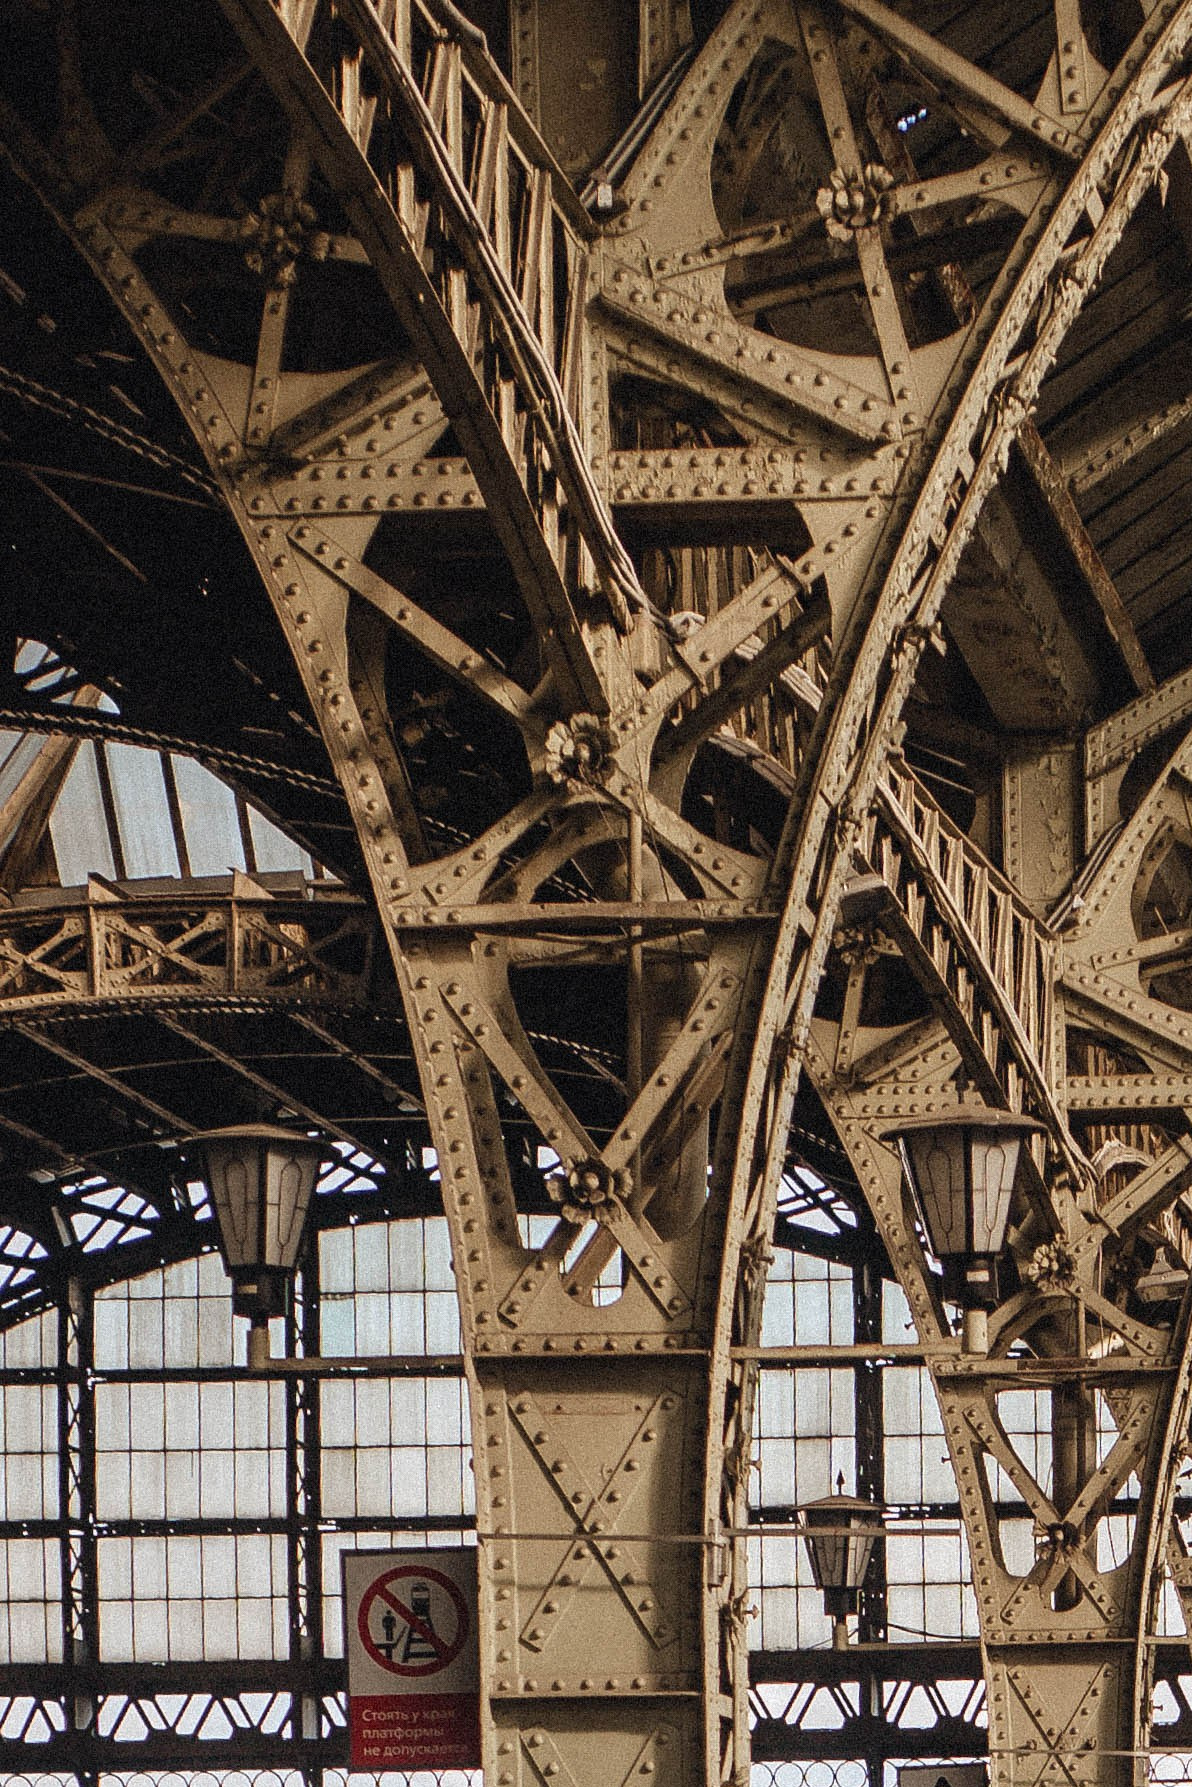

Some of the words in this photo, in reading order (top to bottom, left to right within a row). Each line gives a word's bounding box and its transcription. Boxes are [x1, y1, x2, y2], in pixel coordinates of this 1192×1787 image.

[362, 1709, 409, 1722] Стоять
[412, 1711, 420, 1723] у
[362, 1726, 445, 1740] платформы
[363, 1745, 381, 1757] не
